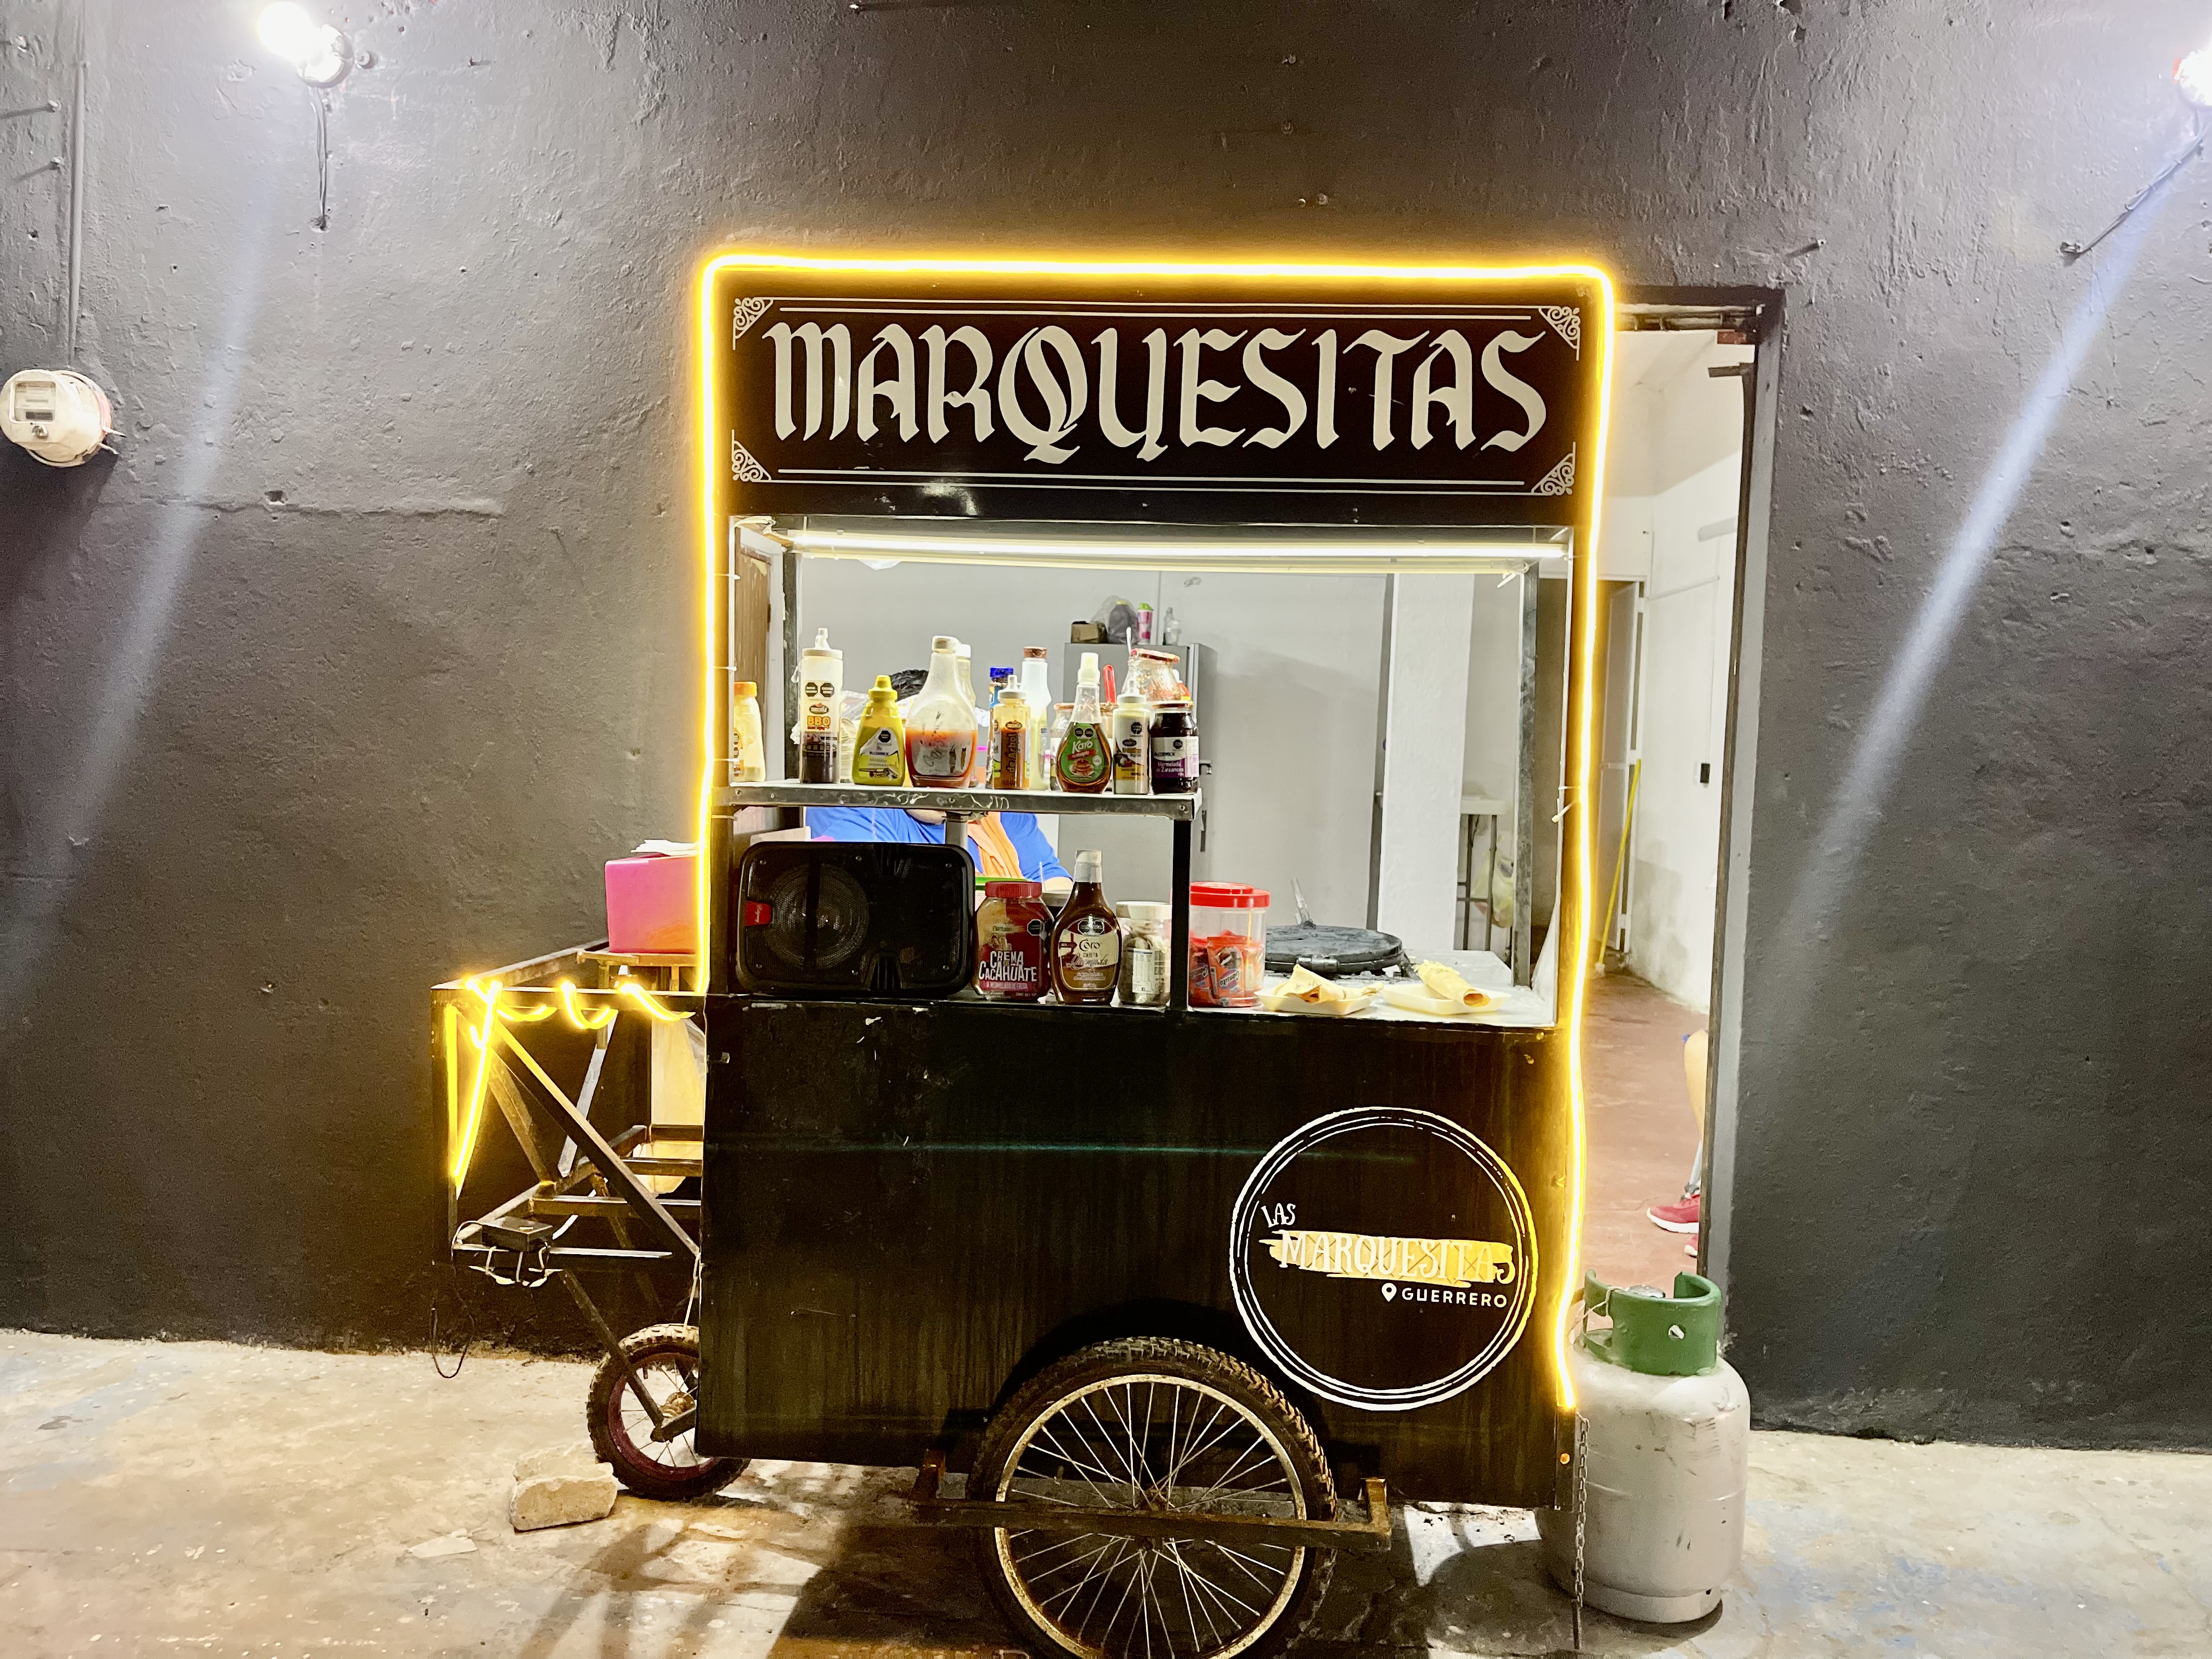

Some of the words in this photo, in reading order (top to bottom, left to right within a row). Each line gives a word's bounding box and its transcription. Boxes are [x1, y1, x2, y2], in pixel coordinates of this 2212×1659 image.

[762, 322, 1547, 464] MARQUESITAS
[807, 715, 831, 729] BBQ
[1071, 740, 1093, 754] Karo
[990, 951, 1024, 968] CREMA
[978, 961, 1037, 982] CACAHUATE
[1261, 1203, 1296, 1227] LAS
[1279, 1229, 1516, 1284] MARQUESITAS
[1402, 1287, 1508, 1308] GUERRERO
